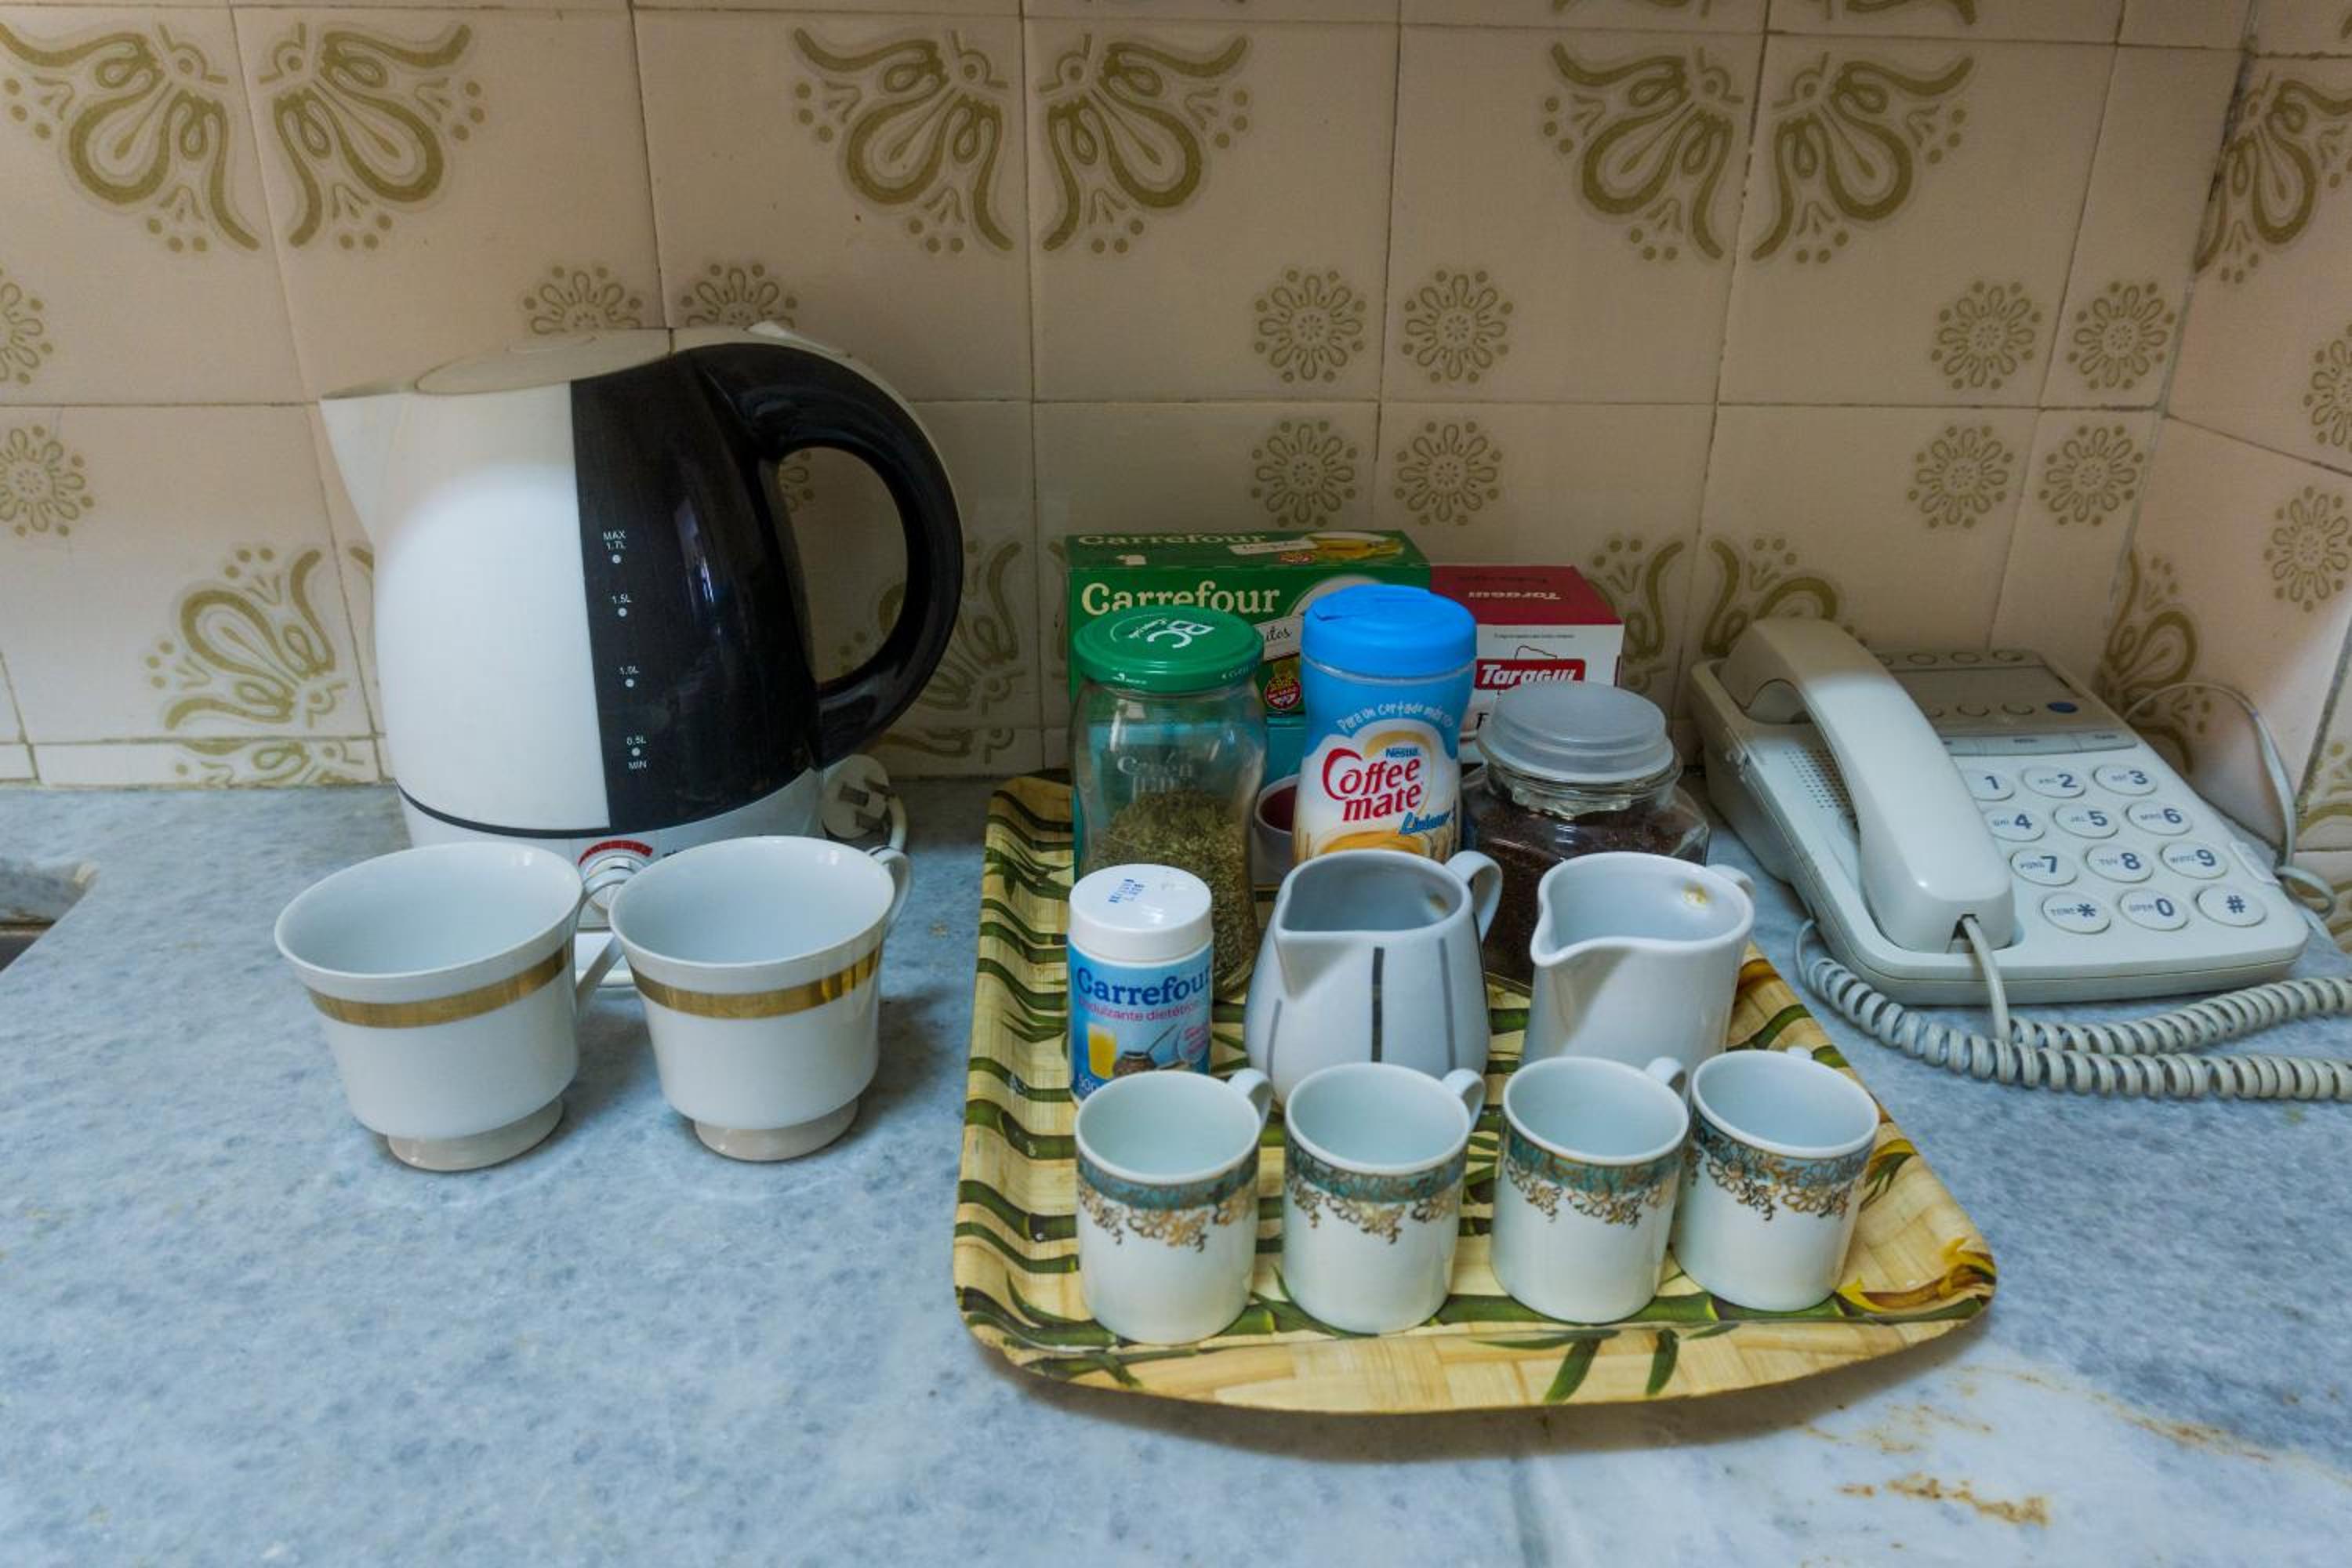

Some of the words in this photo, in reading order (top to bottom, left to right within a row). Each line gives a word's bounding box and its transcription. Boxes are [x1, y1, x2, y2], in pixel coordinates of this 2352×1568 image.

[602, 530, 626, 541] MAX
[1077, 533, 1268, 545] Carrefour
[606, 540, 626, 550] 1.7L
[1081, 581, 1280, 615] Carrefour
[628, 760, 647, 769] MIN
[1323, 748, 1421, 801] Coffee
[1984, 775, 2000, 790] 1
[2057, 773, 2078, 788] 2
[2129, 770, 2149, 786] 3
[1342, 783, 1422, 822] mate
[2014, 813, 2033, 830] 4
[2087, 810, 2109, 827] 5
[2162, 808, 2183, 824] 6
[2040, 855, 2058, 874] 7
[2120, 852, 2142, 870] 8
[2195, 848, 2216, 866] 9
[2155, 898, 2176, 916] 0
[1076, 965, 1210, 1006] Carrefour
